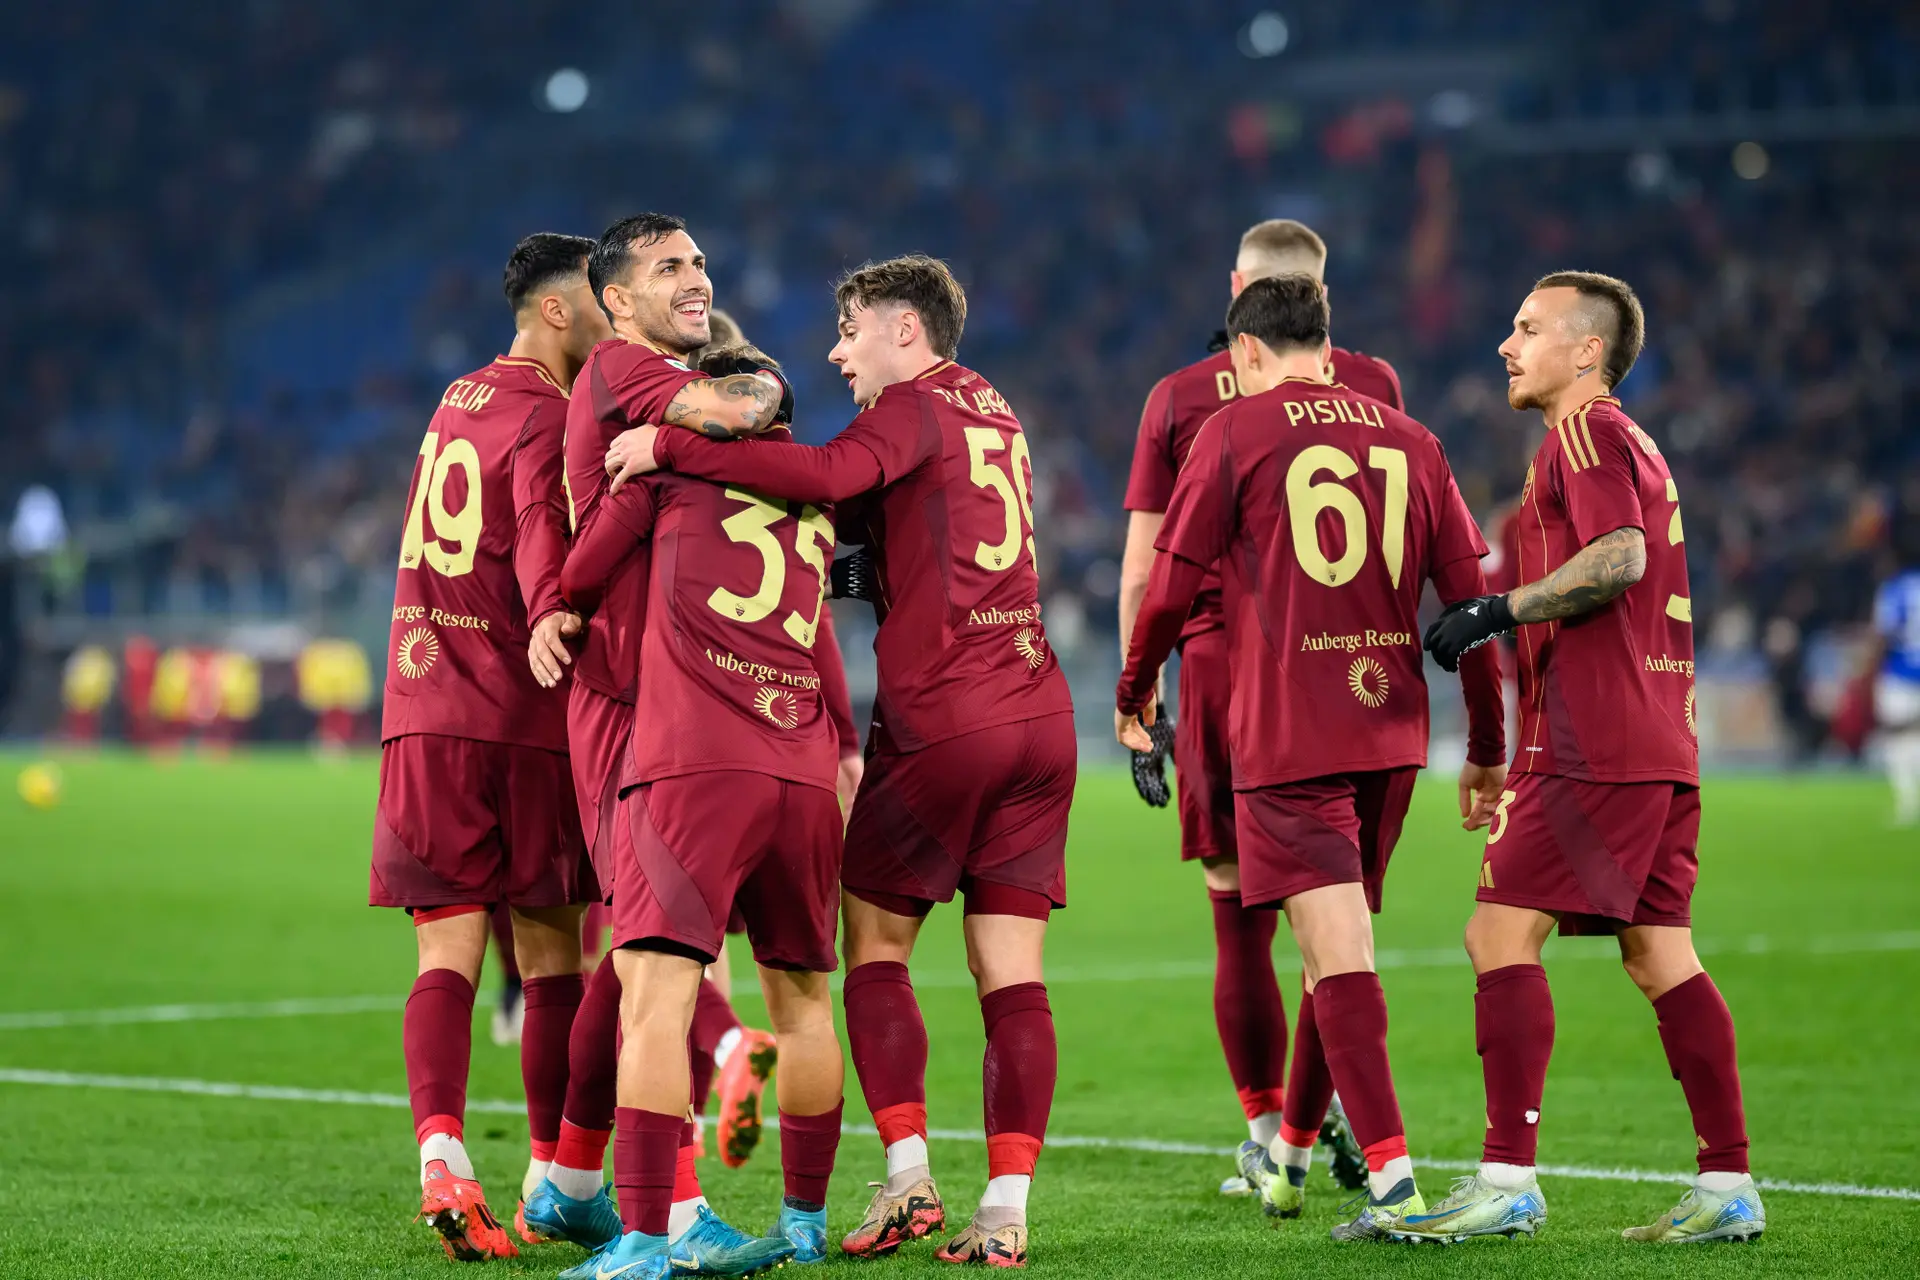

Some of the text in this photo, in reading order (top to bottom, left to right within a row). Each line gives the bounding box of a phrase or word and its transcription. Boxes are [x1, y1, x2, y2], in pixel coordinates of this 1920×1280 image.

[1283, 399, 1385, 429] PISILLI
[399, 432, 483, 578] 19
[1286, 445, 1409, 590] 61
[967, 602, 1034, 626] Auberge
[1300, 631, 1362, 653] Auberge
